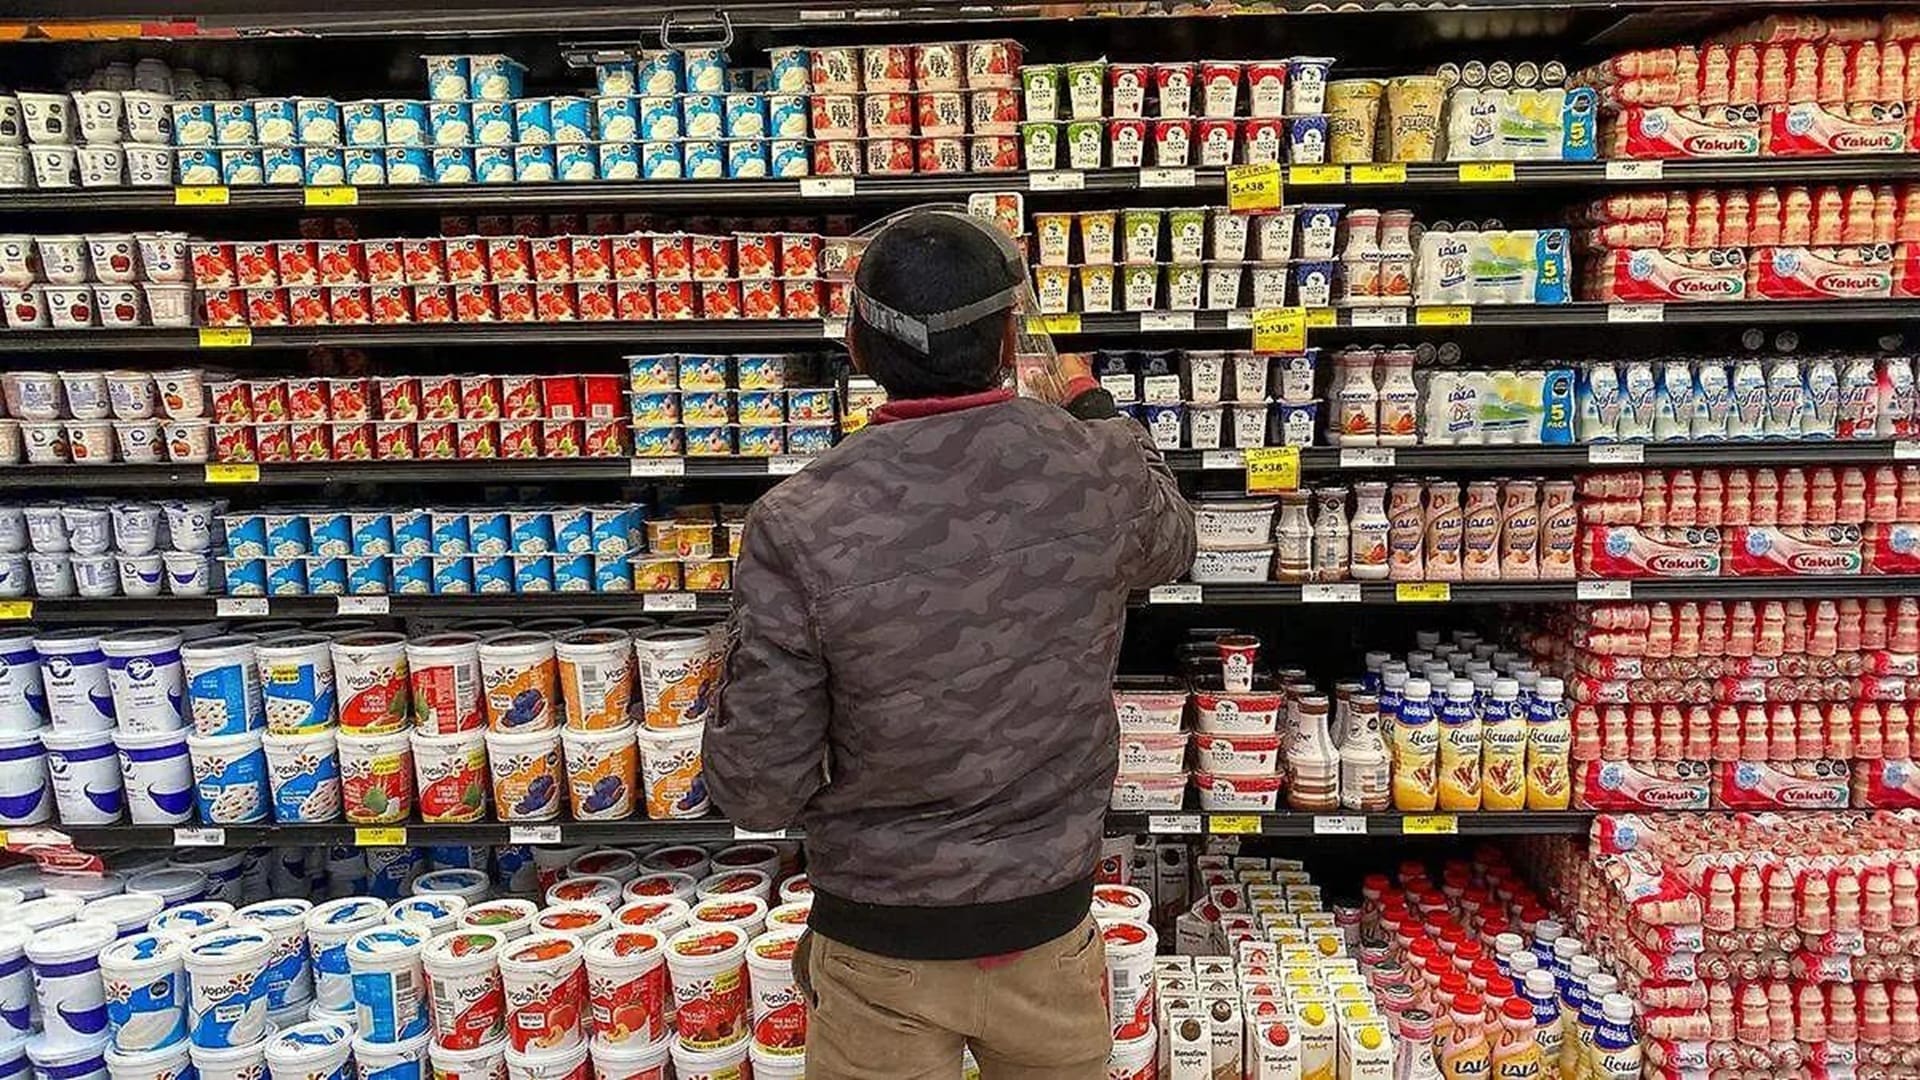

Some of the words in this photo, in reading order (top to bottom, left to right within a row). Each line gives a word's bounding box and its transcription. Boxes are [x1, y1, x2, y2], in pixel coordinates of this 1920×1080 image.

[1570, 123, 1586, 140] 5
[1695, 138, 1746, 151] Yakult
[1840, 136, 1892, 148] Yakult
[1438, 244, 1468, 256] LALA
[1544, 260, 1556, 276] 5
[1681, 280, 1732, 293] Yakult
[1827, 278, 1879, 290] Yakult
[1550, 405, 1564, 420] 5
[1658, 558, 1707, 570] Yakult
[1798, 556, 1849, 568] Yakult
[1650, 790, 1698, 801] Yakult
[1788, 790, 1836, 801] Yakult
